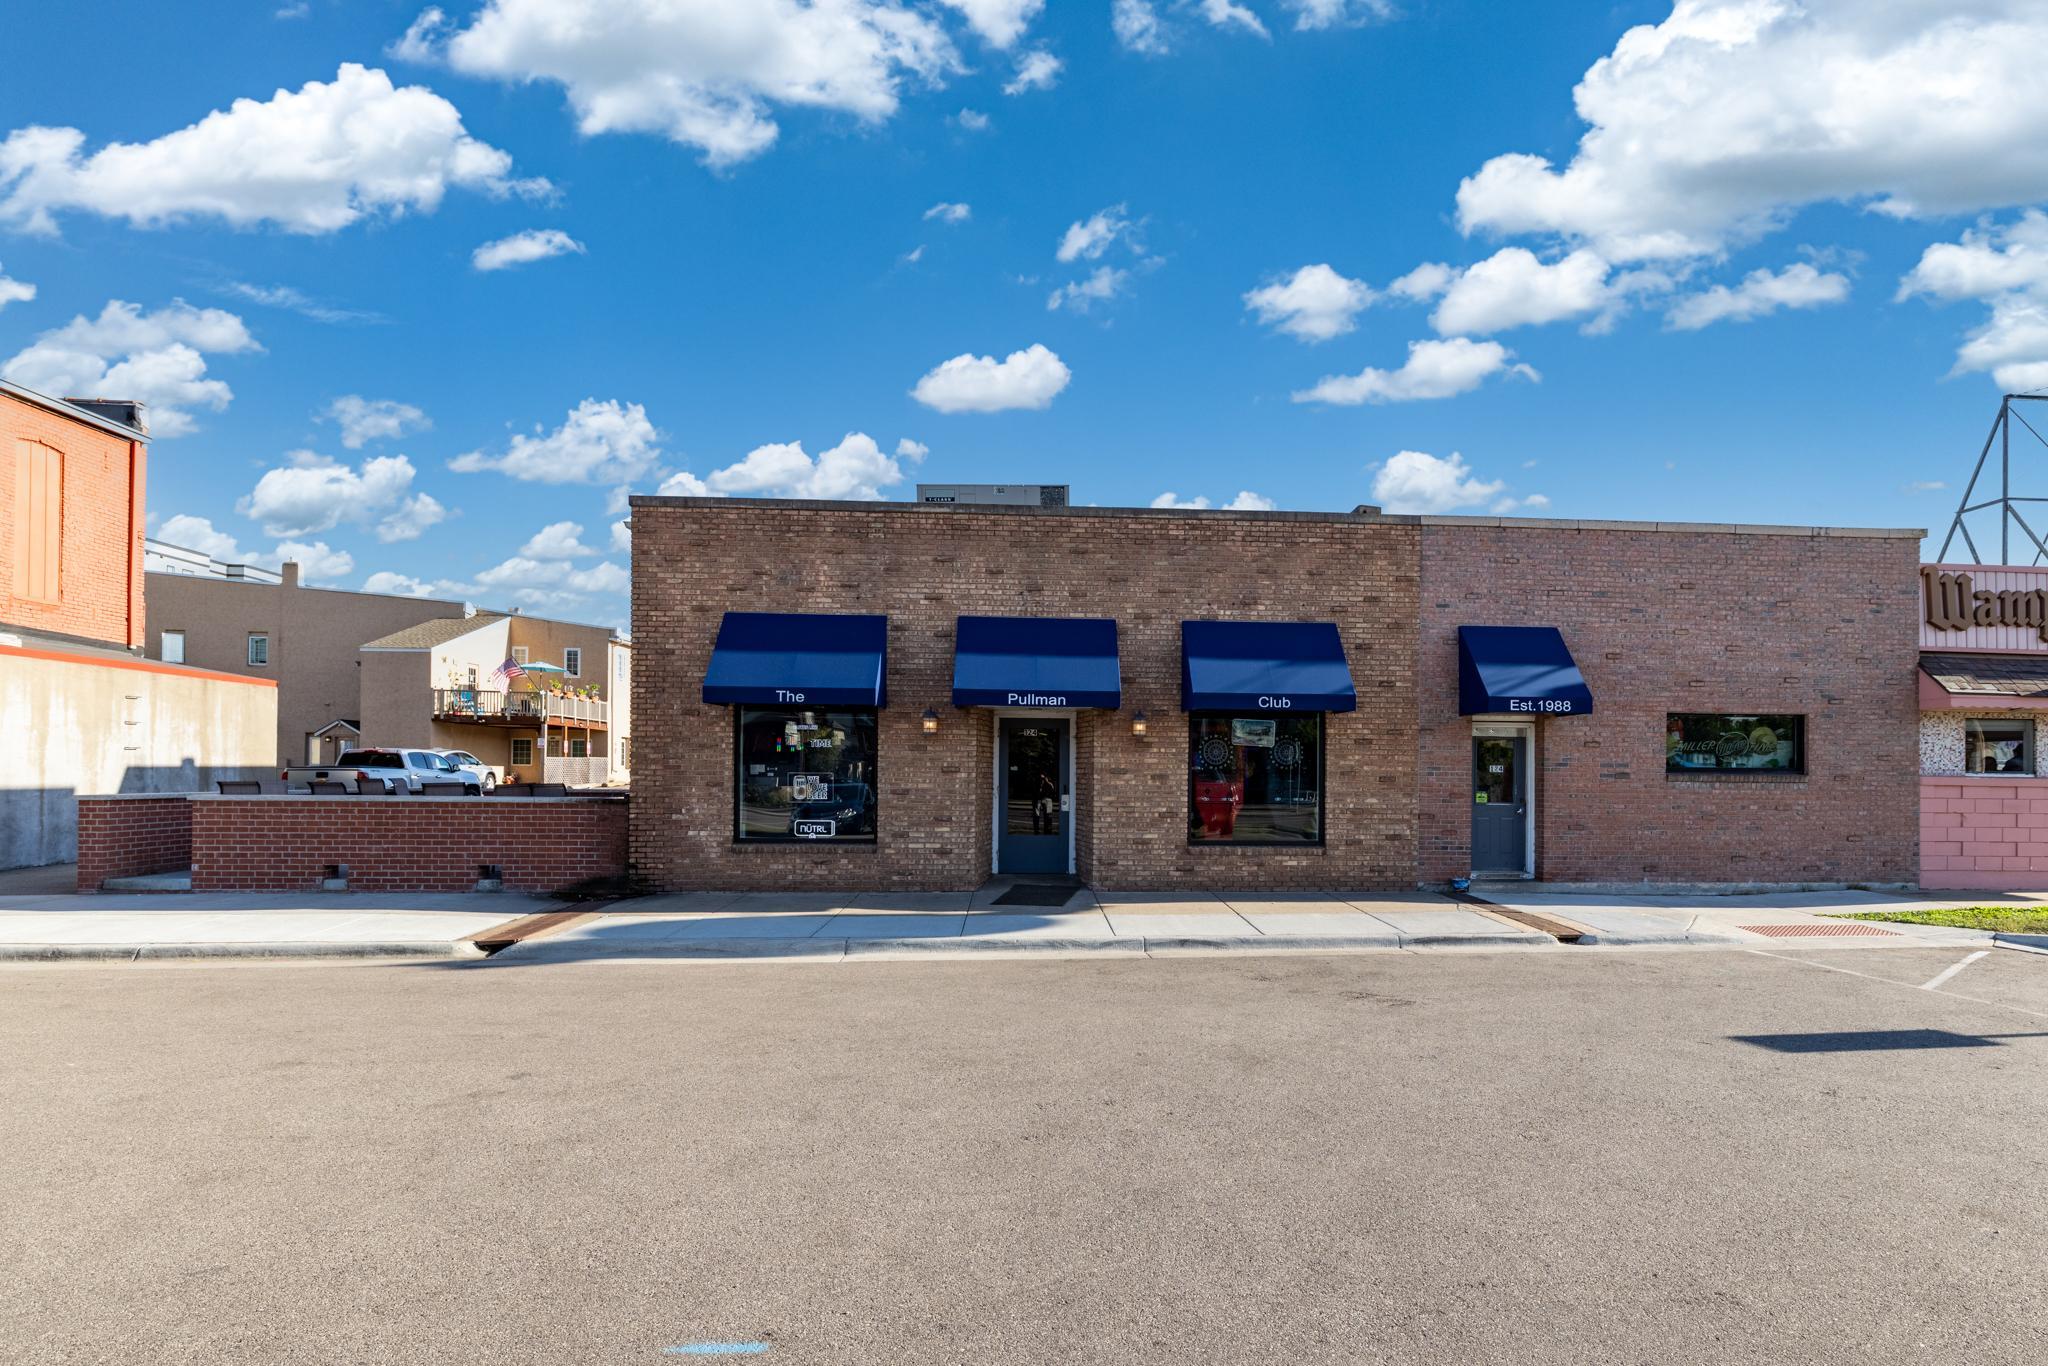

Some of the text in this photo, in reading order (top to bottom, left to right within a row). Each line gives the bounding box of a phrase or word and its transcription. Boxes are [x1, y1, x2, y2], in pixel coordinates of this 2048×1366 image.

[776, 690, 805, 702] The
[1008, 693, 1066, 706] Pullman
[1258, 696, 1291, 708] Club
[1679, 740, 1716, 752] MILLER
[1489, 765, 1504, 773] 124
[807, 783, 828, 791] LOVE
